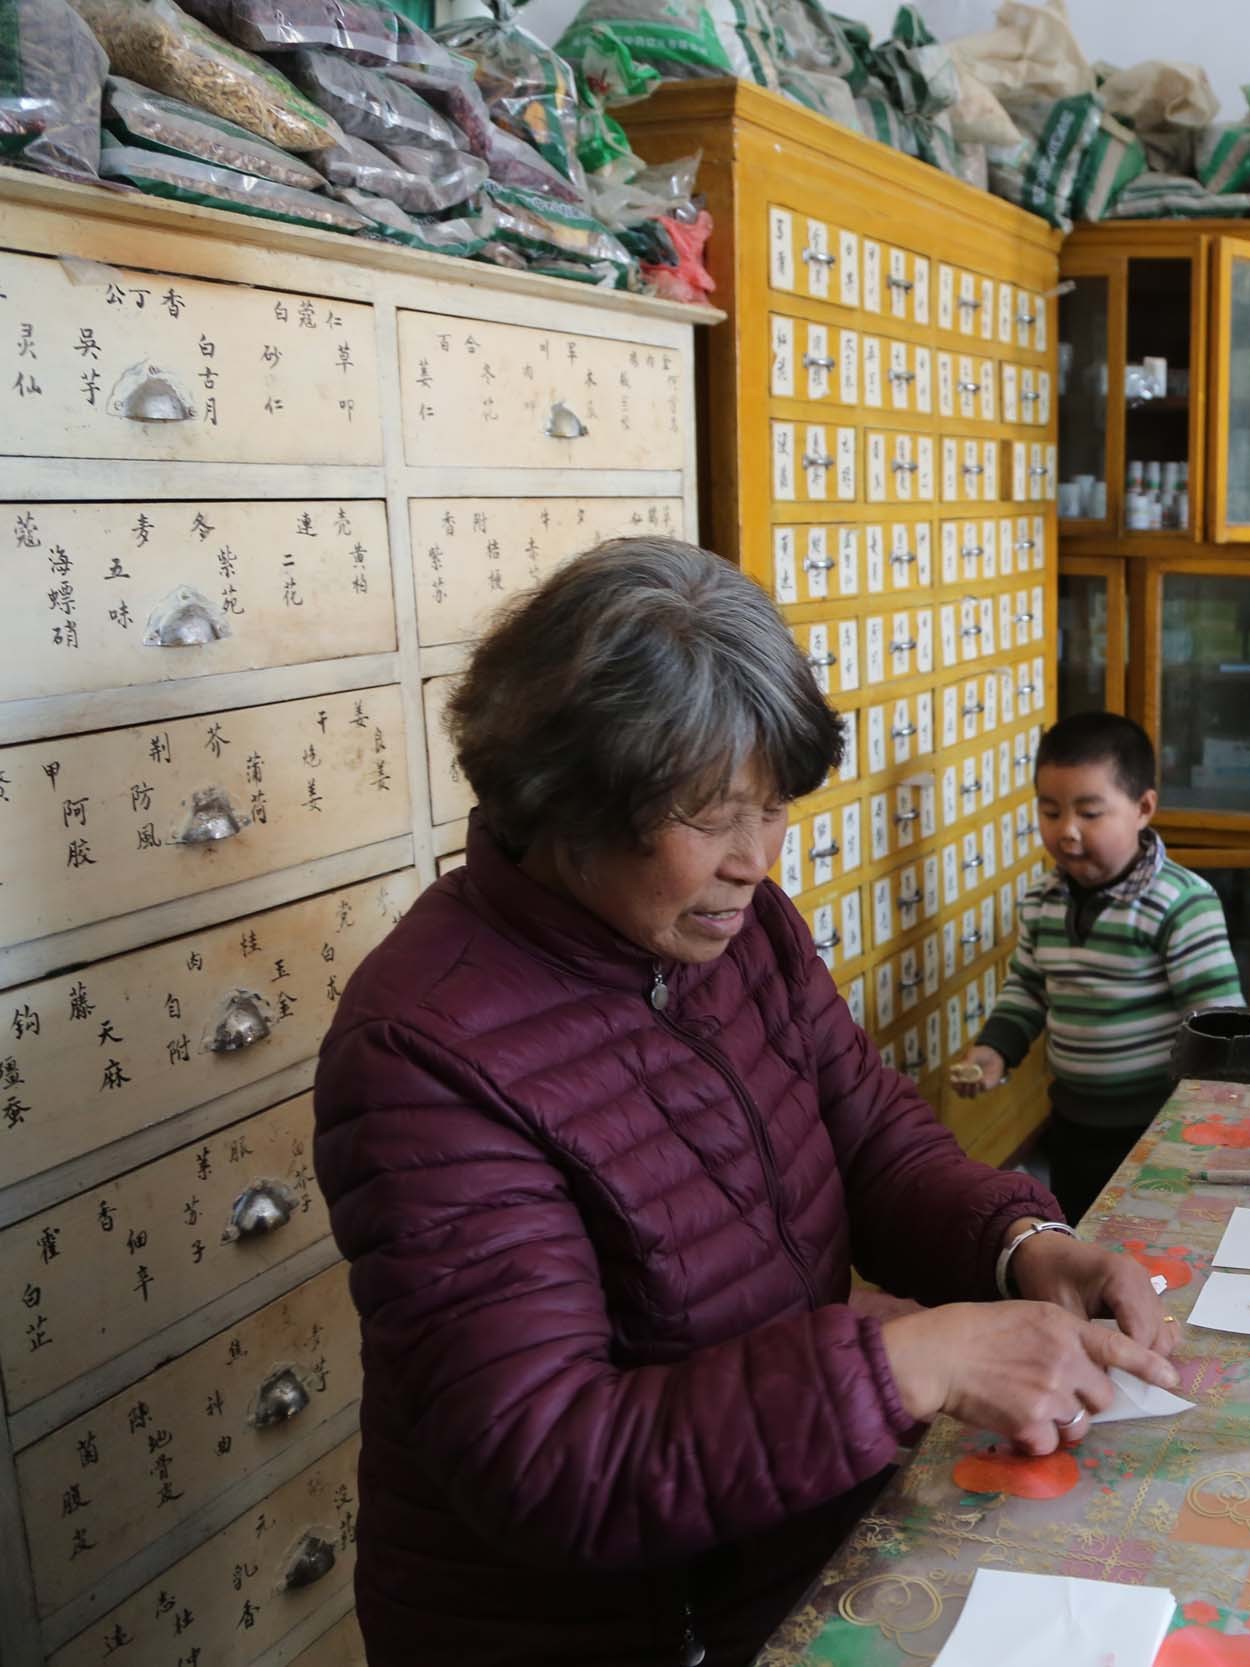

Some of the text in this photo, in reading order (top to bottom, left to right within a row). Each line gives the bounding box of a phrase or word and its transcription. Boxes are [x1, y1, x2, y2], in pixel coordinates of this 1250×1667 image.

[105, 284, 186, 318] 公丁香
[103, 557, 134, 630] 五味
[282, 553, 304, 606] 二花
[316, 700, 370, 735] 干姜
[97, 1019, 132, 1090] 天麻
[21, 1282, 54, 1353] 白芷
